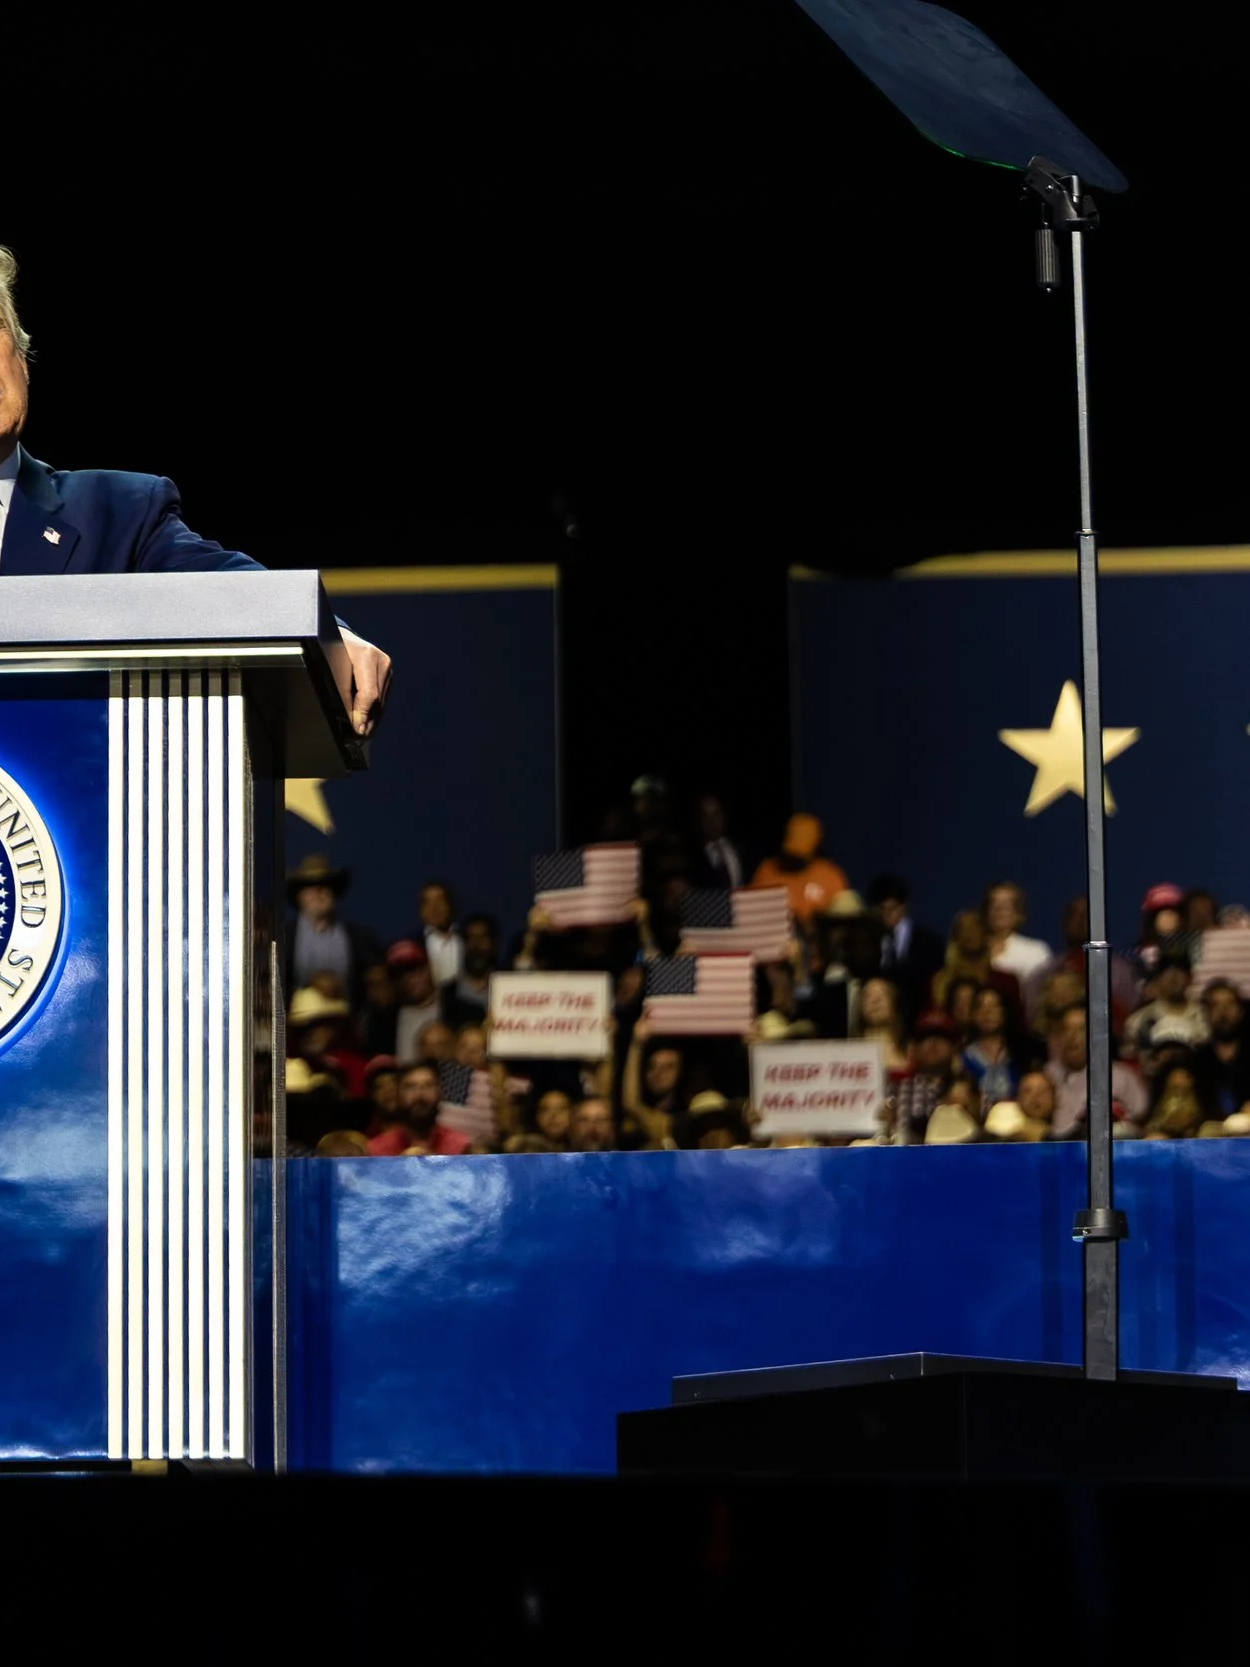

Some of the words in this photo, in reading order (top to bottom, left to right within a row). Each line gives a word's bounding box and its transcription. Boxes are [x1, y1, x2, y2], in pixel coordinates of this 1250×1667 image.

[501, 991, 551, 1009] KEEP
[558, 991, 595, 1009] THE
[764, 1062, 822, 1081] KEEP
[829, 1060, 871, 1080] THE
[761, 1089, 875, 1110] MAJORITY
